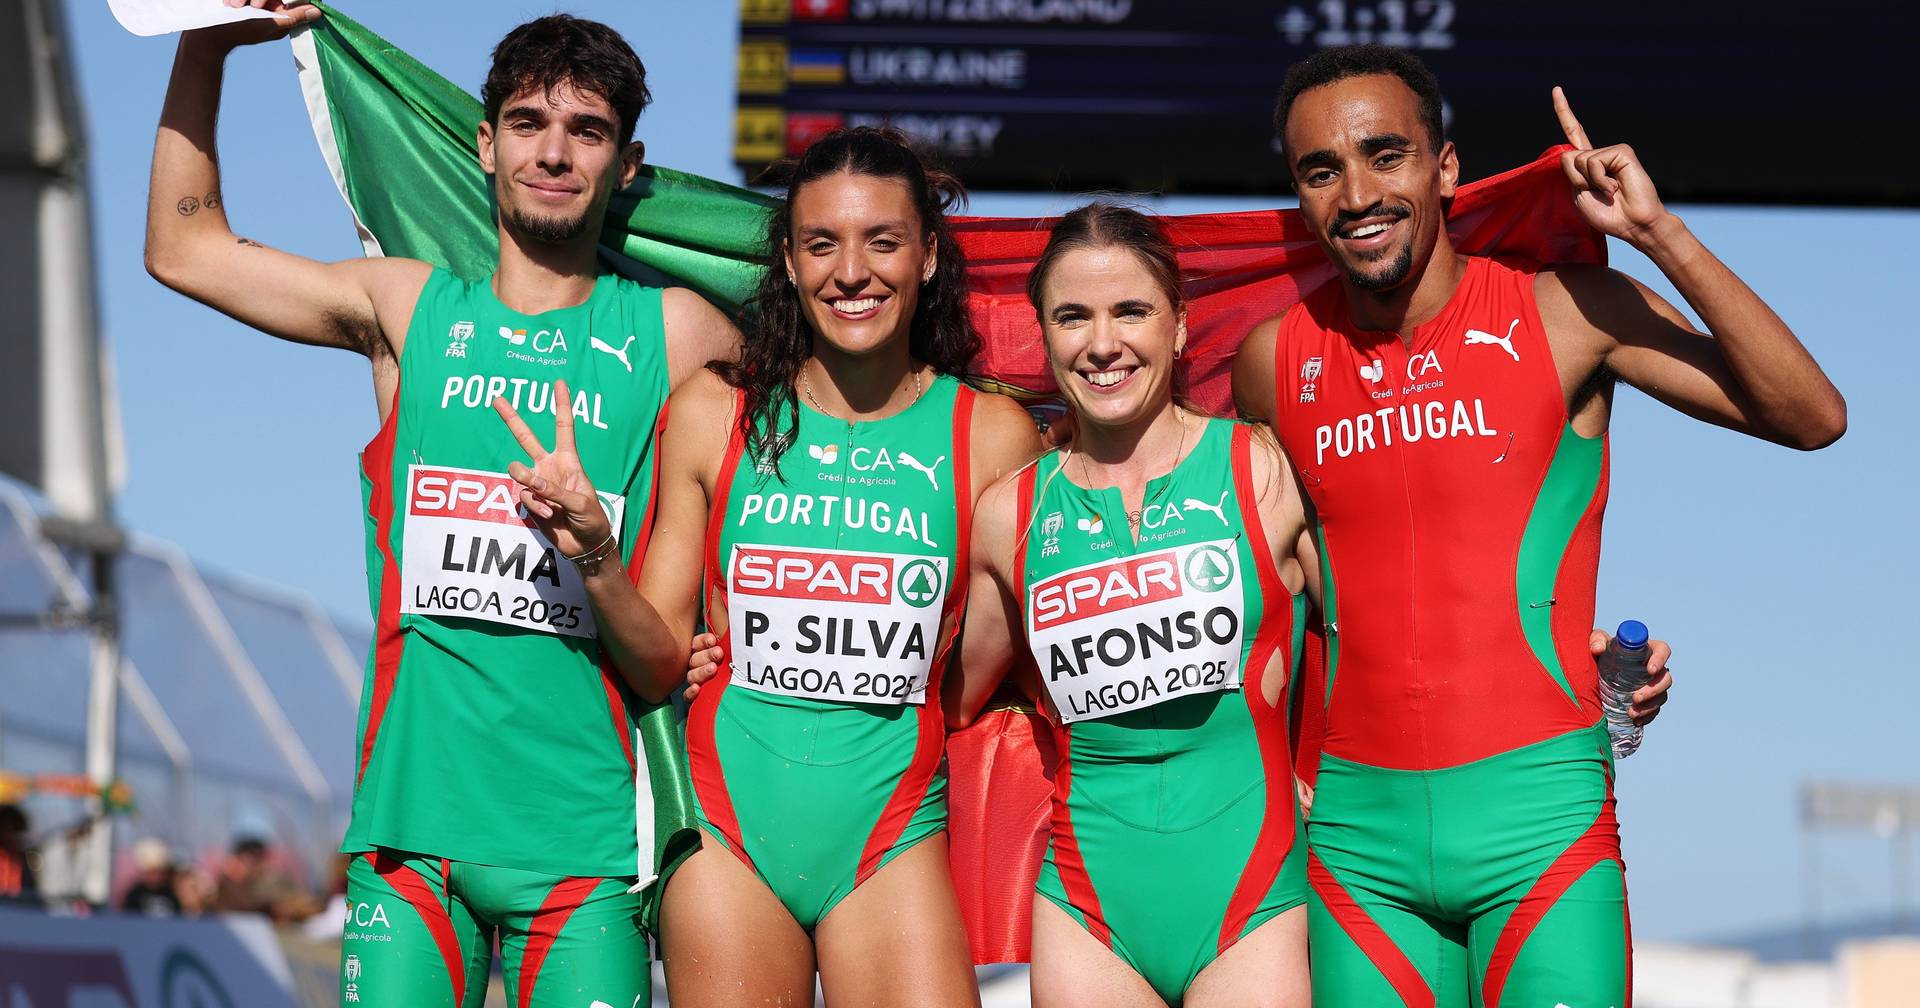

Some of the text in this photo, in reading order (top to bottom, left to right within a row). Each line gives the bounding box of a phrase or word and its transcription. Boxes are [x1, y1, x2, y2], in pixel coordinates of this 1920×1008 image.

[850, 50, 1027, 86] UKRAINE
[445, 348, 467, 359] FPA
[532, 328, 568, 353] CA
[1407, 349, 1443, 381] CA
[441, 374, 609, 430] PORTUAL
[1300, 391, 1316, 403] FPA
[1316, 398, 1497, 465] PORTUGAL
[850, 447, 896, 472] CA
[415, 476, 528, 519] SPA
[1142, 502, 1185, 529] CA
[738, 493, 938, 548] PORTUGAL
[441, 533, 561, 588] LIMA
[1041, 545, 1061, 559] FPA
[738, 556, 888, 598] SPAR
[1036, 559, 1177, 623] SPAR
[415, 585, 583, 630] LAGOA 2025
[745, 610, 925, 660] P. SILVA
[1050, 606, 1238, 682] AFONSO
[747, 661, 917, 698] LAGOA 2025
[1068, 660, 1228, 716] LAGOA 2025
[355, 902, 391, 929] CA
[345, 991, 360, 1003] FPA
